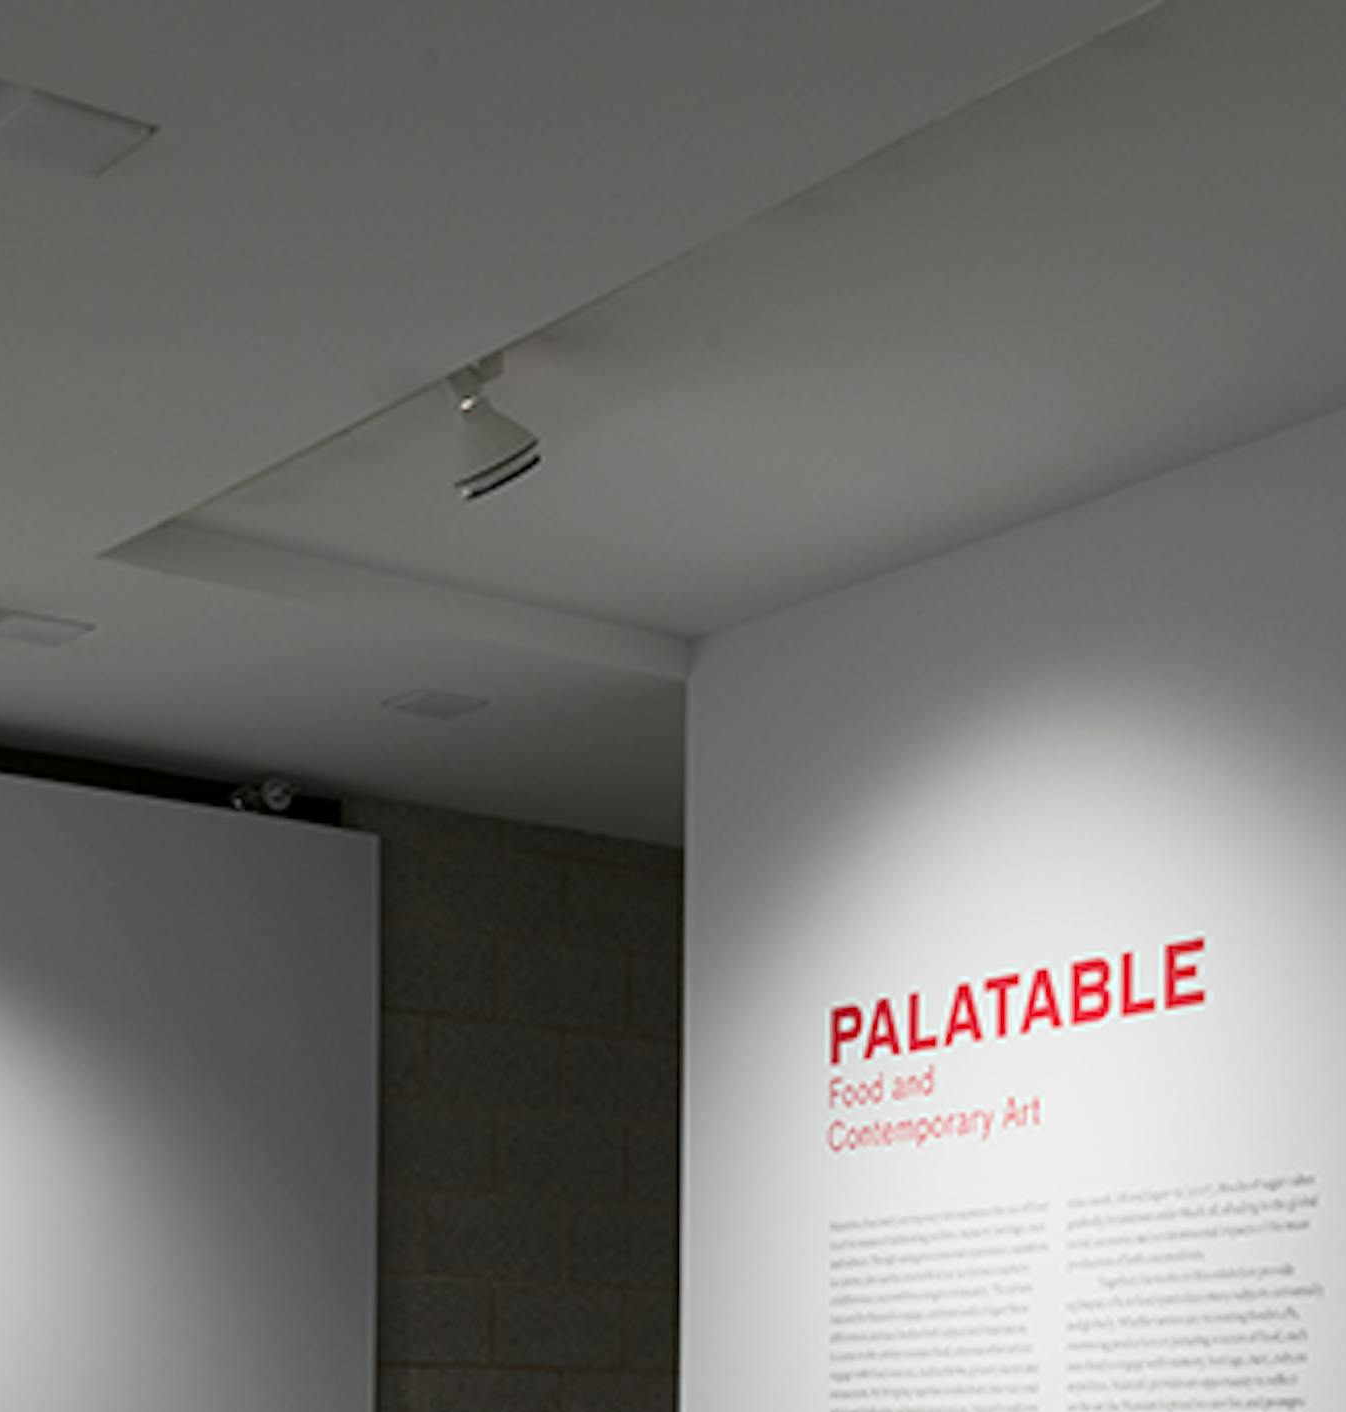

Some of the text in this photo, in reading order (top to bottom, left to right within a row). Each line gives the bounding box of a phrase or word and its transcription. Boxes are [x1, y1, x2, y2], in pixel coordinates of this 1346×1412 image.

[829, 937, 1206, 1066] PALATABLE
[828, 1066, 934, 1109] Food and
[827, 1097, 1041, 1153] Contemporary Art
